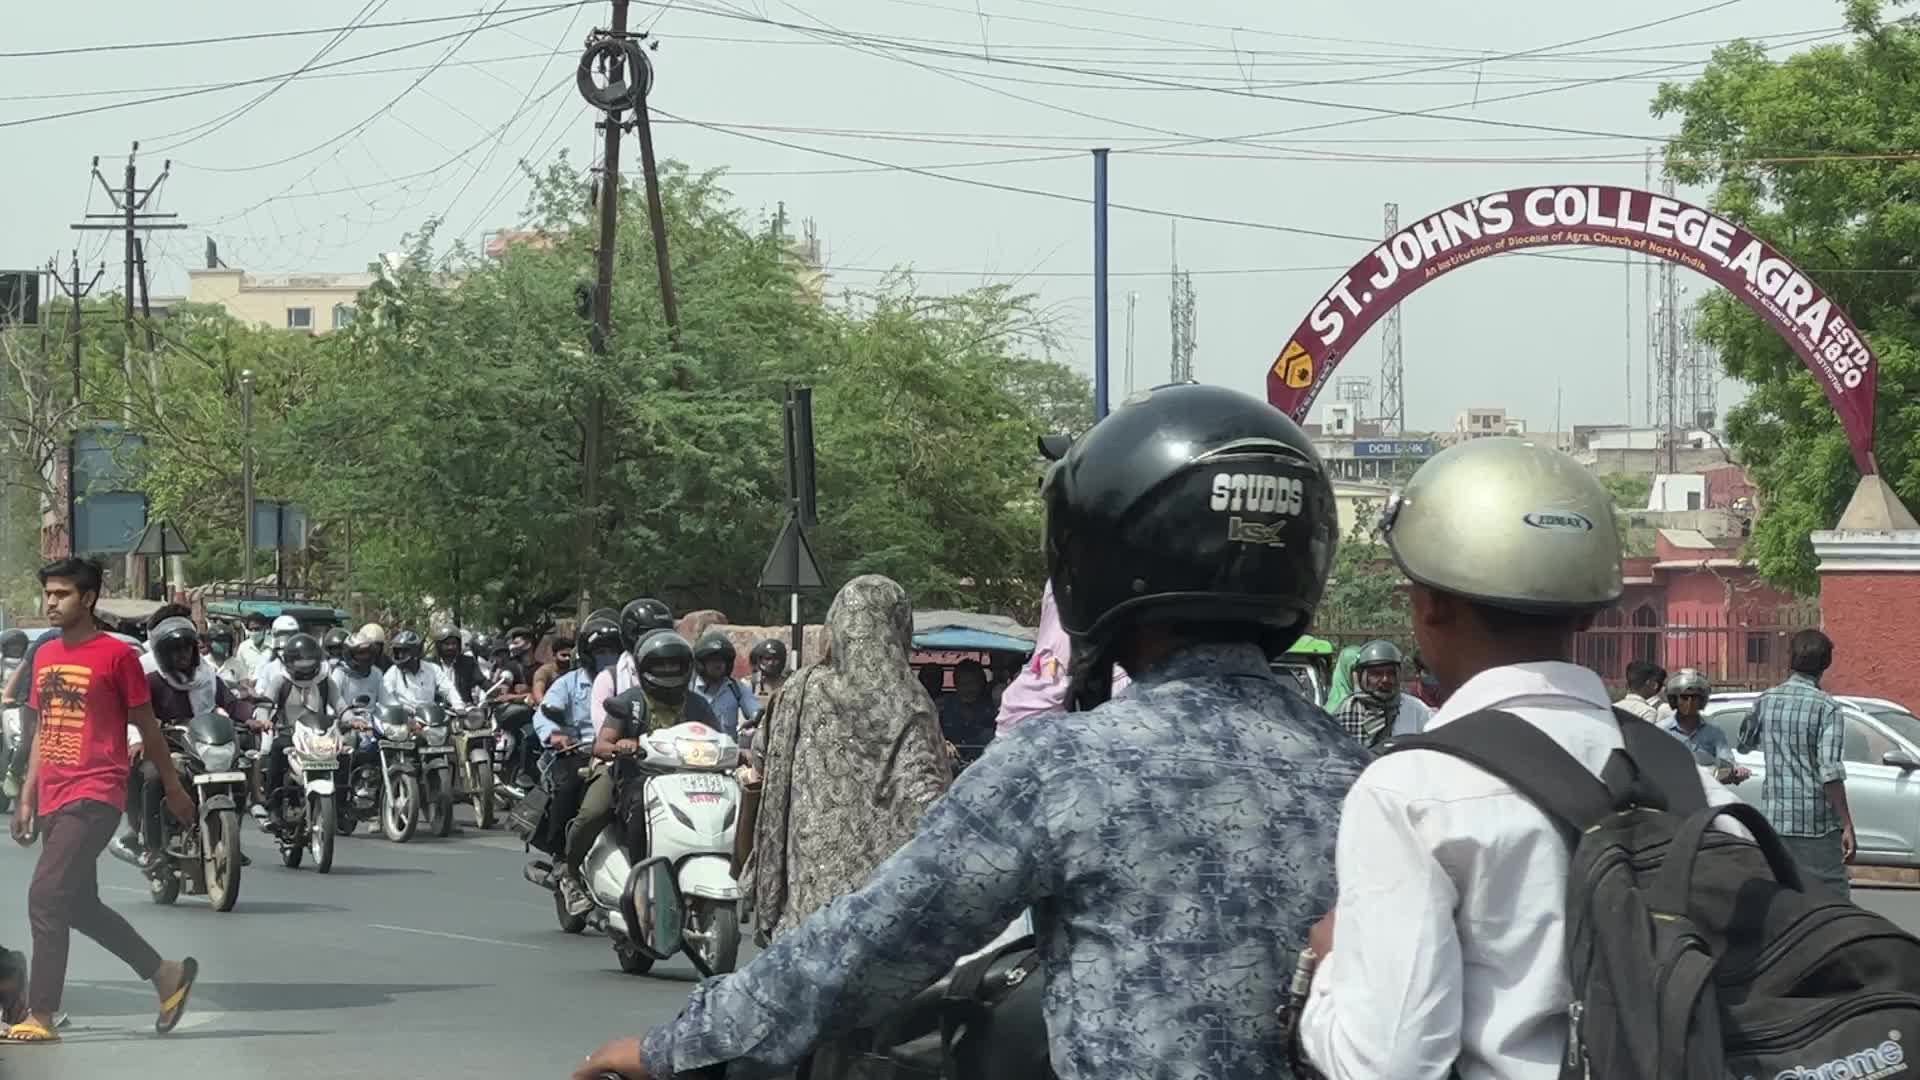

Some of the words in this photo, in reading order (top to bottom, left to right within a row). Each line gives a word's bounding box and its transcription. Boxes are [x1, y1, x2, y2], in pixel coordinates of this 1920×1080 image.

[1310, 275, 1372, 345] ST.
[1370, 193, 1513, 289] JOHN'S
[1728, 240, 1832, 344] AGRA
[1425, 267, 1438, 279] An
[1438, 244, 1492, 272] Institution
[1495, 239, 1505, 250] of
[1508, 234, 1549, 246] Diocese
[1551, 231, 1563, 241] of
[1593, 232, 1632, 247] Church
[1633, 239, 1645, 249] of
[1648, 242, 1680, 259] North
[1819, 335, 1863, 388] 1850
[1210, 473, 1303, 516] STUDDS
